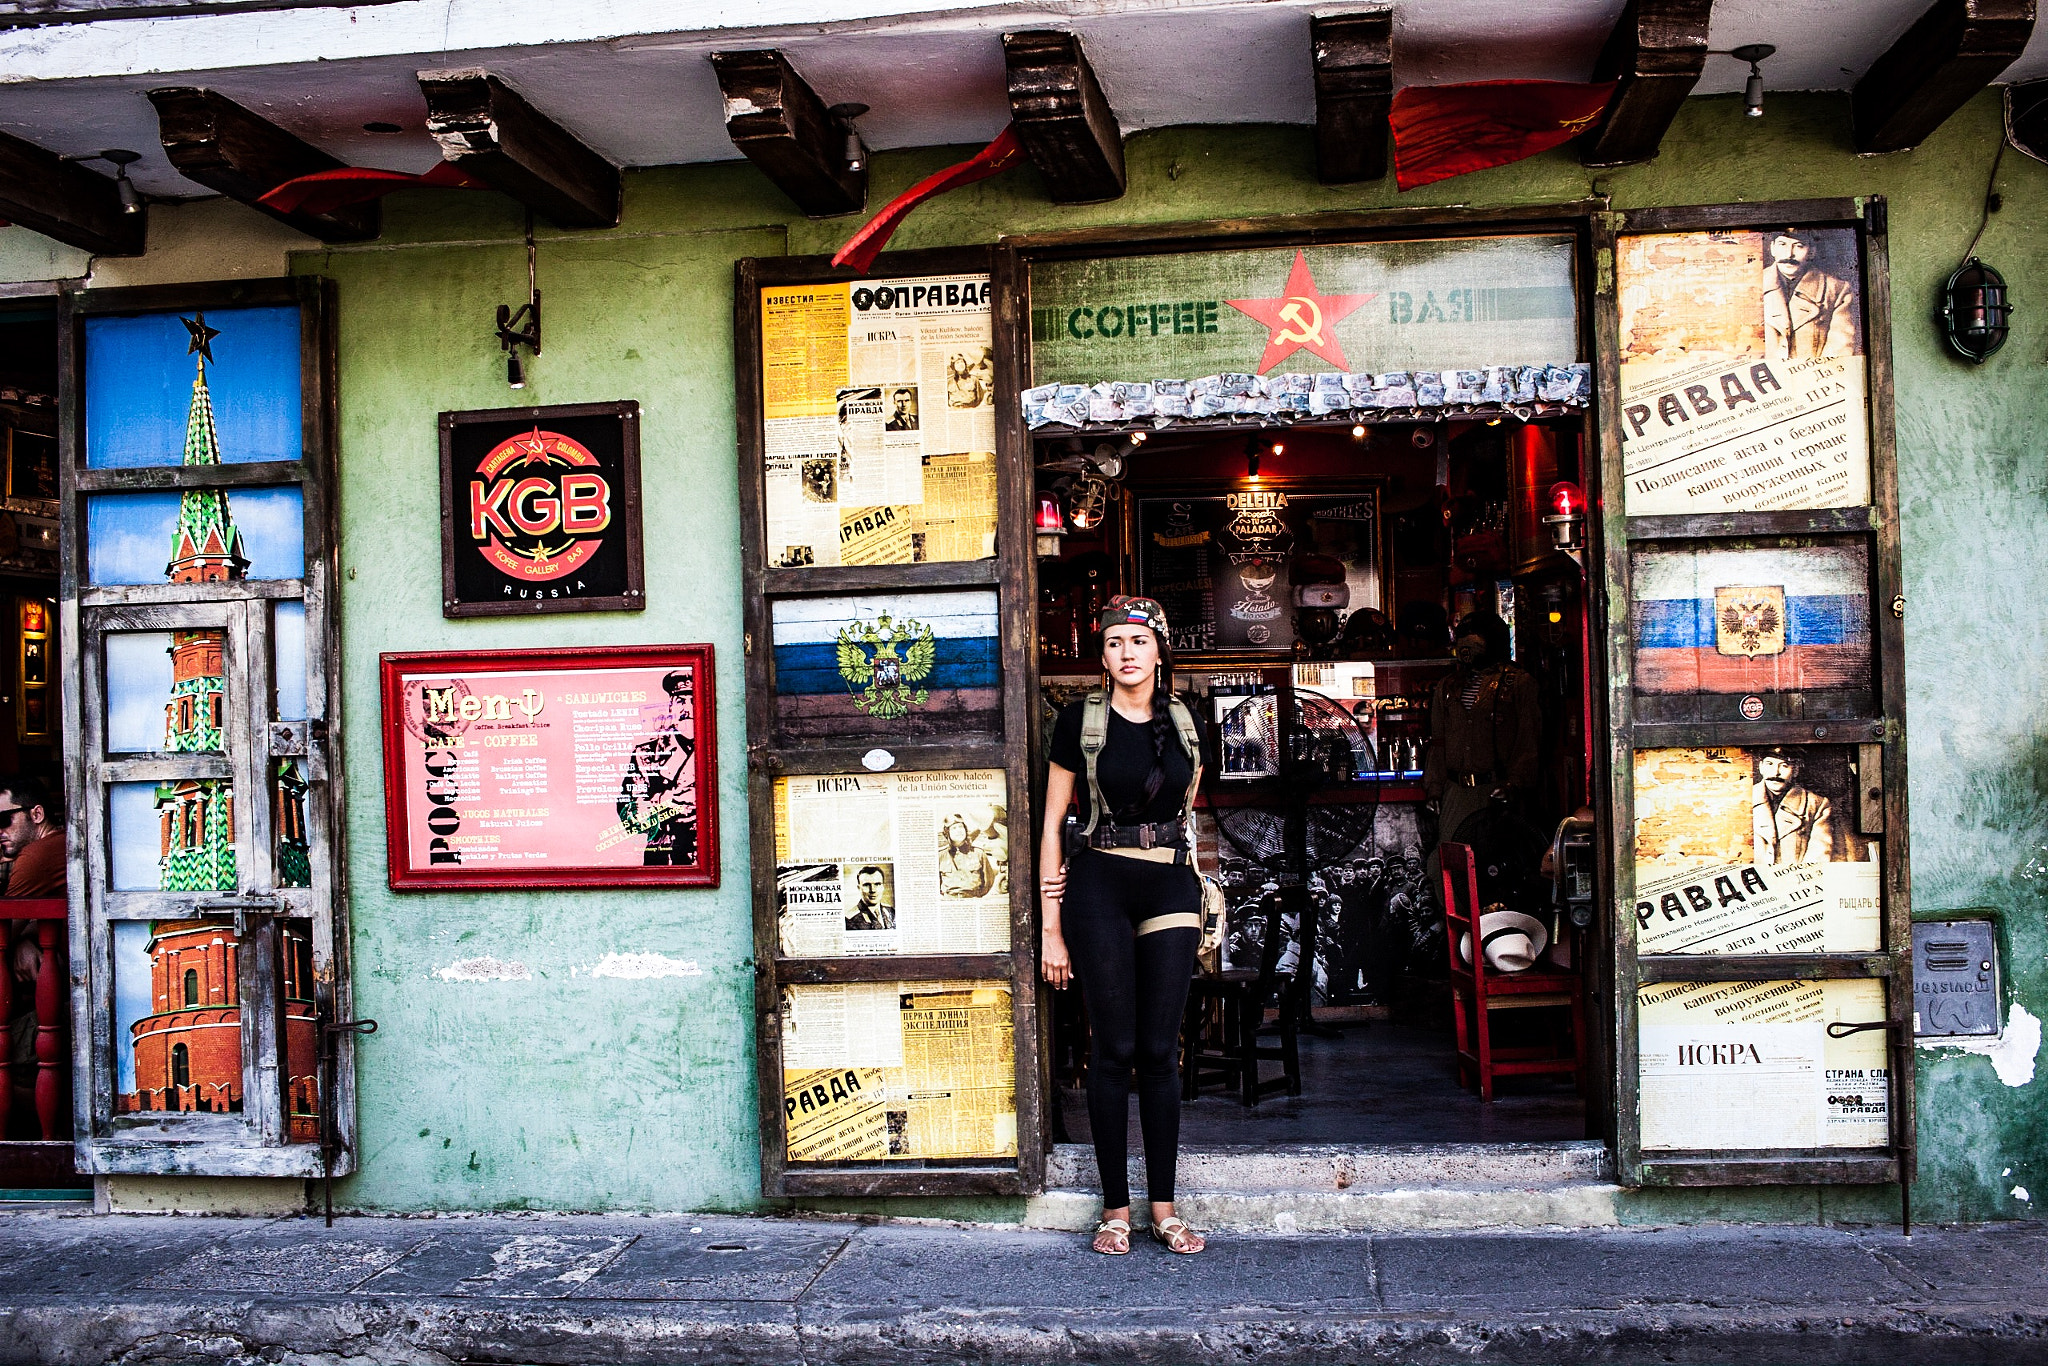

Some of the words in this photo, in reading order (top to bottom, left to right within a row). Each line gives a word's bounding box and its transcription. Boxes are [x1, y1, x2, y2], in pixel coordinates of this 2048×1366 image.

[766, 294, 814, 306] ИЗВЕСТИЯ
[894, 282, 992, 309] ПРАВДА
[1068, 301, 1218, 340] COFFEE
[848, 406, 884, 415] ПРАВДА
[1637, 430, 1695, 453] Центрального
[1697, 414, 1736, 432] Комитета
[486, 445, 516, 474] CARTAGENA
[556, 441, 586, 464] COLOMBIA
[1635, 454, 1727, 496] Подписание
[1733, 441, 1768, 461] акта
[1687, 455, 1785, 498] капитуляции
[1722, 459, 1827, 505] вооруженных
[470, 473, 611, 540] KGB
[1226, 492, 1289, 508] DELEITA
[1235, 524, 1278, 535] PALADAR
[494, 549, 519, 570] KOFEE
[524, 562, 560, 575] GALLERY
[503, 580, 586, 599] RUSSIA
[565, 691, 647, 705] SANDWICHES
[484, 734, 538, 748] COFFEE
[816, 776, 861, 793] ИСКРА
[897, 773, 924, 784] Viktor
[963, 770, 993, 781] halcón
[897, 784, 909, 793] de
[910, 783, 920, 792] la
[920, 782, 947, 792] Unión
[949, 781, 988, 791] Soviética
[462, 809, 491, 819] JUGOS
[493, 807, 550, 818] NATURALES
[449, 835, 501, 845] SMOOTHIES
[789, 884, 842, 893] МОСКОВСКАЯ
[788, 892, 842, 904] ПРАВДА
[1839, 897, 1873, 911] РЫЦАРЬ
[1641, 923, 1693, 944] Центрального
[1694, 912, 1728, 928] Комитета
[1726, 936, 1756, 953] акта
[1714, 979, 1806, 1017] вооруженных
[903, 1011, 934, 1021] ПЕРВАЯ
[937, 1009, 969, 1020] ЛУННАЯ
[903, 1019, 969, 1031] ЭКСПЕДИЦИЯ
[1678, 1043, 1763, 1066] ИСКРА
[1825, 1069, 1864, 1079] СТРАНА
[1842, 1106, 1886, 1114] ПРАВДА
[788, 1134, 836, 1161] Подписание
[838, 1125, 856, 1138] акта
